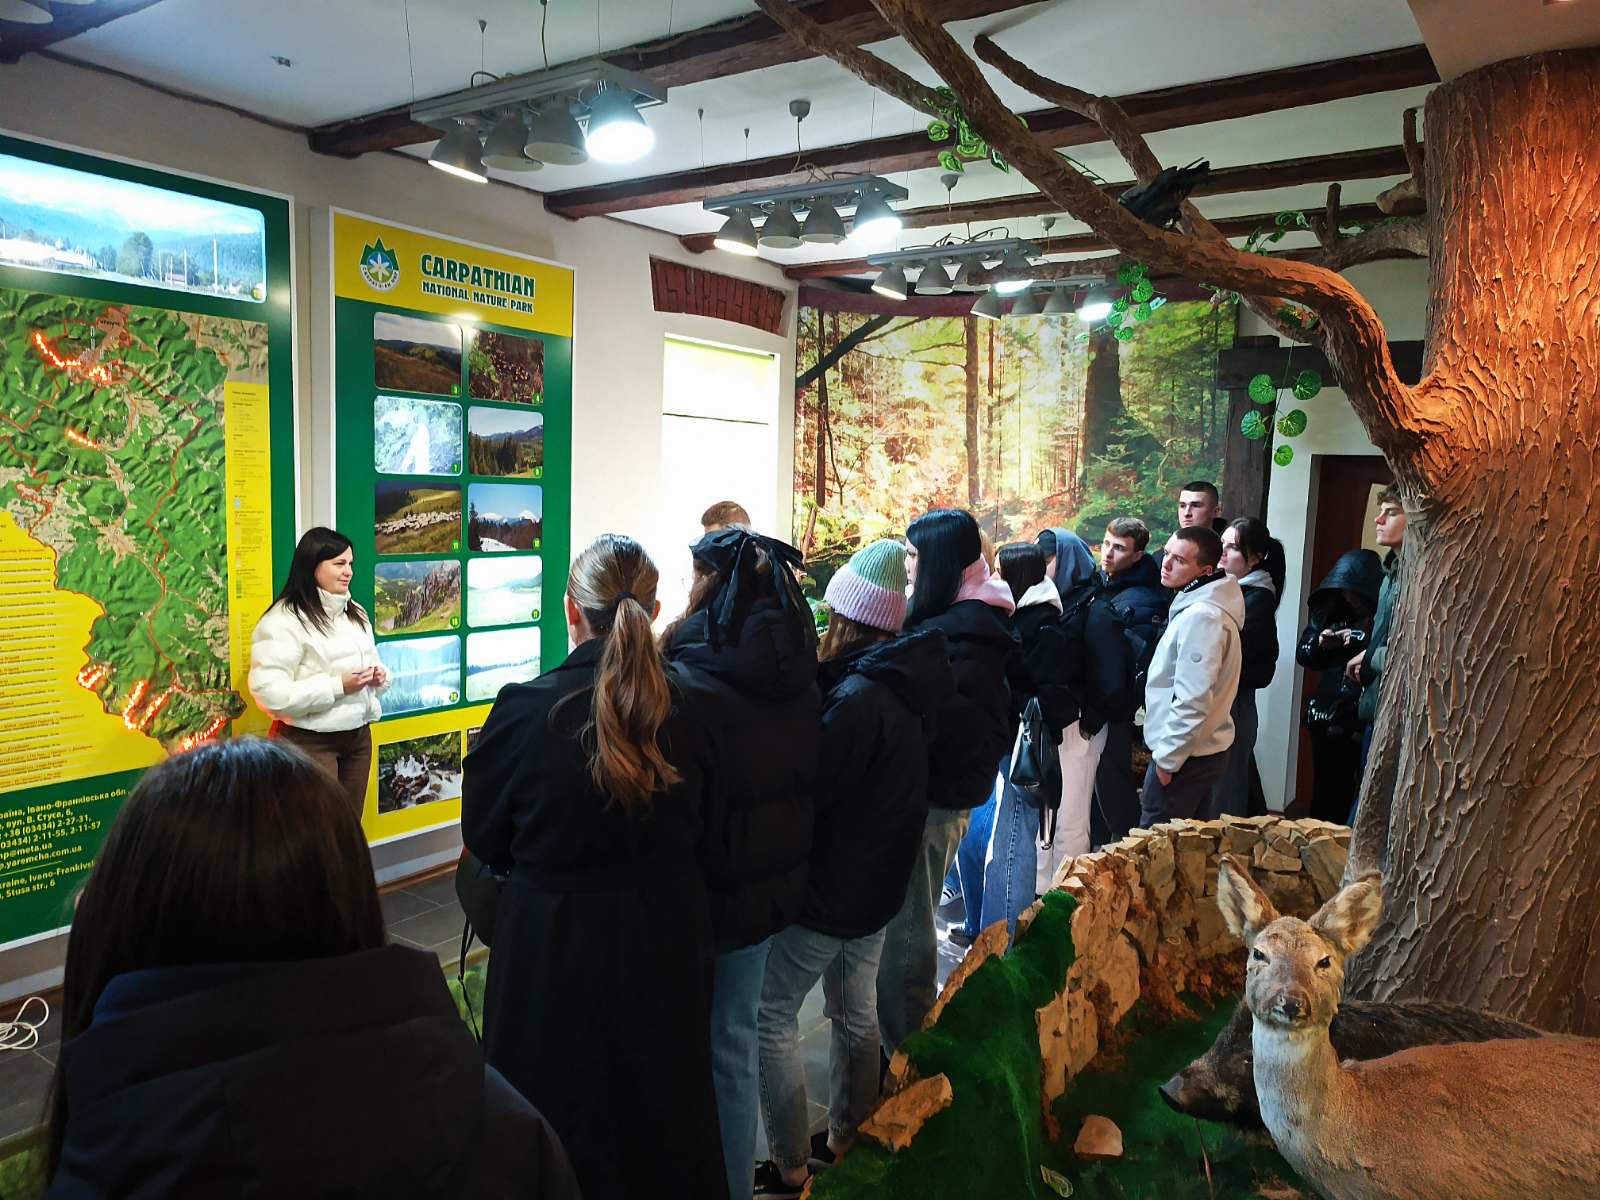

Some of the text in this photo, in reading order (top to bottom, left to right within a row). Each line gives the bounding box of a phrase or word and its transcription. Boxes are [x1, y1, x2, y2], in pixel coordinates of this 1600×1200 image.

[421, 254, 535, 298] CARPATHIAN
[422, 281, 533, 314] NATIONAL NATURE PARK
[27, 793, 109, 814] Івано-Франківська
[22, 820, 56, 836] (03434)
[70, 821, 101, 835] 2-11-57
[6, 886, 30, 898] Stusa
